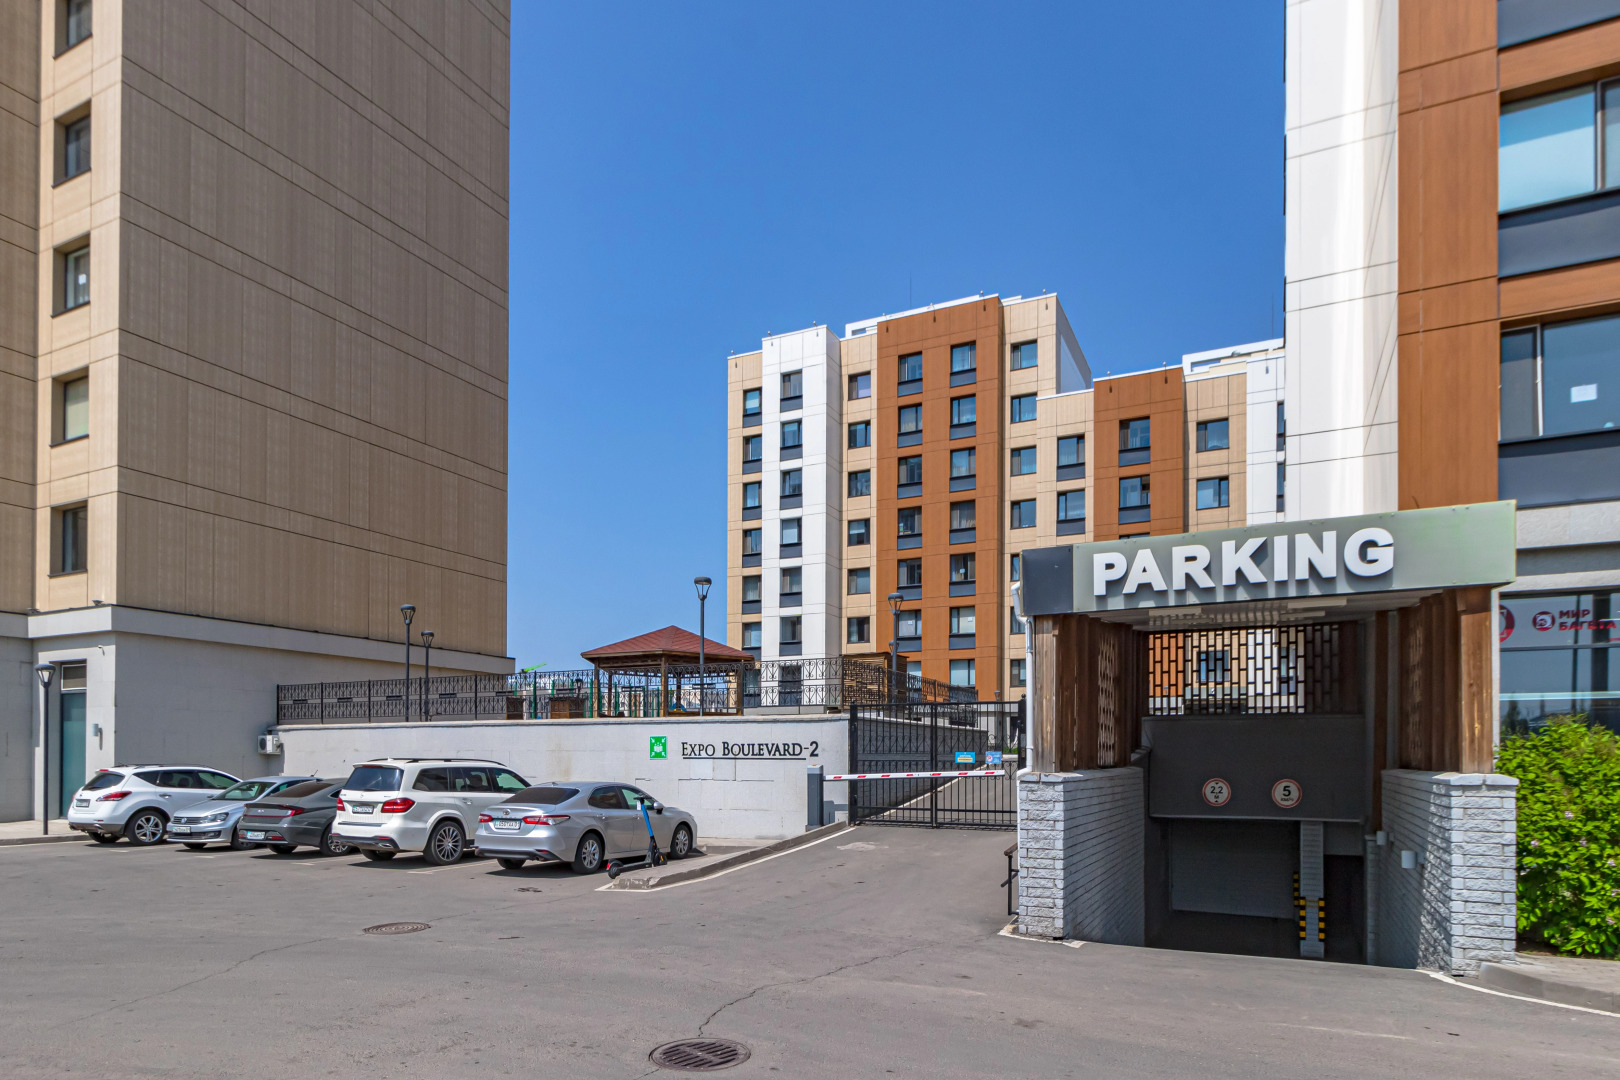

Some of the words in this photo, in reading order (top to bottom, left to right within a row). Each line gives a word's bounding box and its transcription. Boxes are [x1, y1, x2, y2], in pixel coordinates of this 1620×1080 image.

[1093, 527, 1395, 597] PARKING
[1559, 609, 1591, 619] МИР
[1559, 620, 1617, 631] БАГЕТА
[1282, 785, 1292, 797] 5
